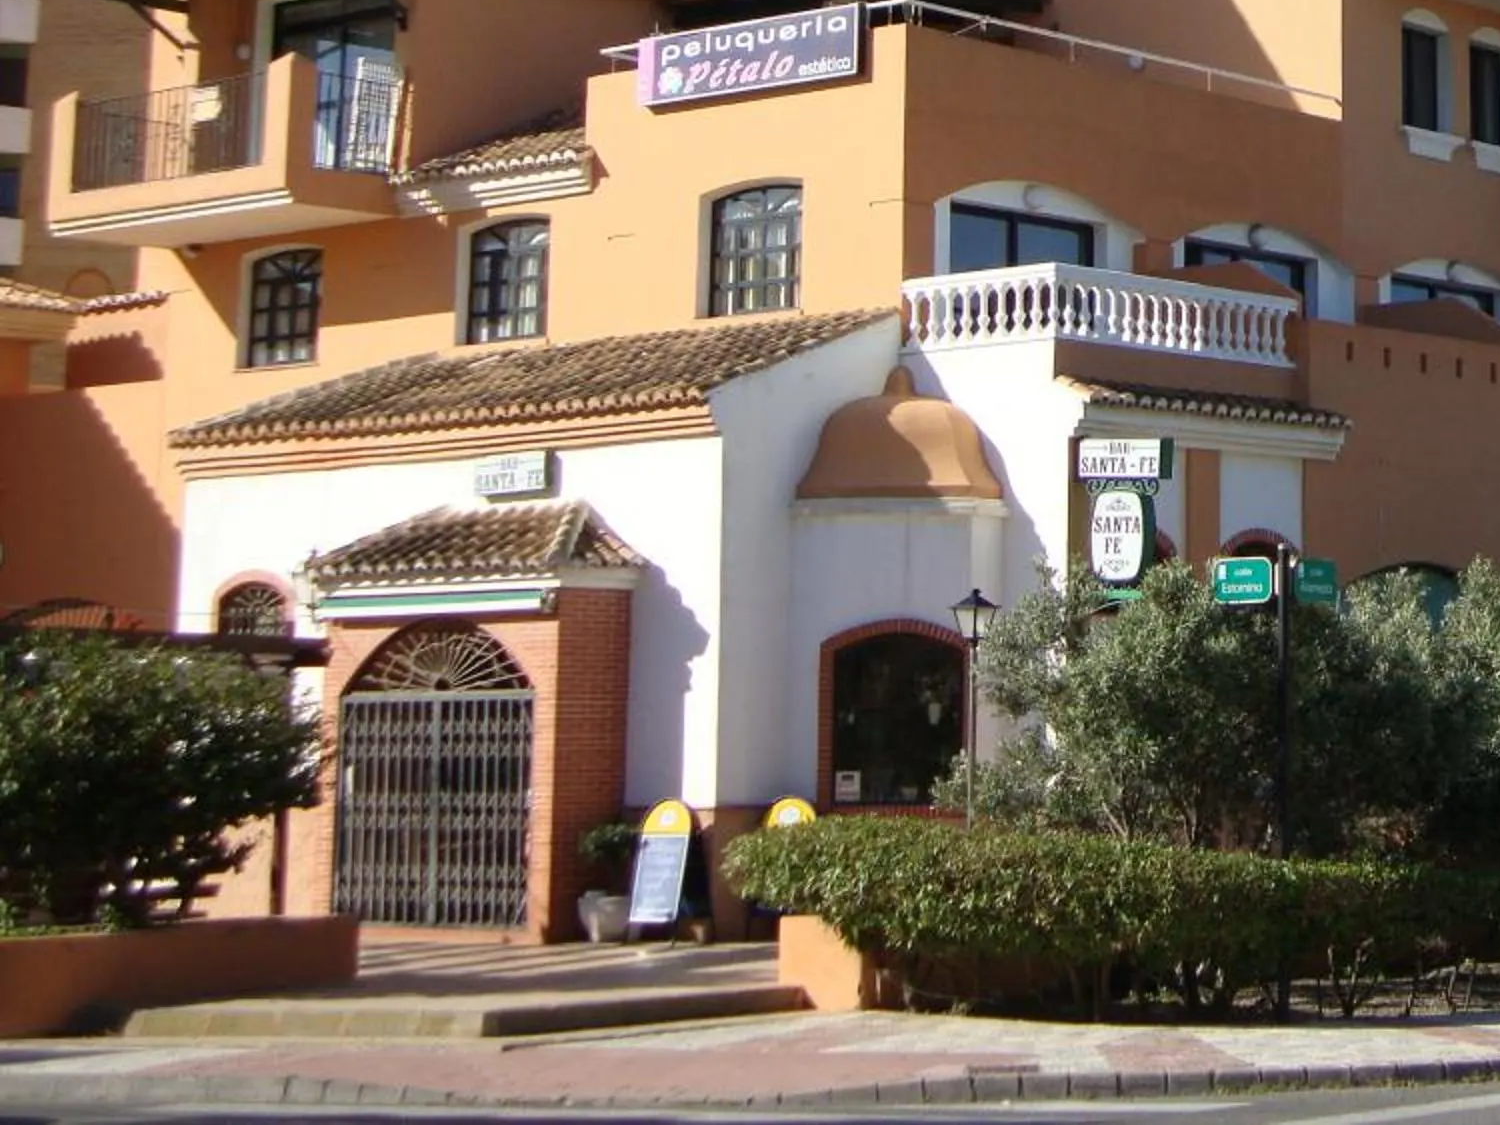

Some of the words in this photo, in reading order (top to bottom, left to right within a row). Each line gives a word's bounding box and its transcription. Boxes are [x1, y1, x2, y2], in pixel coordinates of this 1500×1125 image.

[683, 50, 795, 95] Pétalo
[1081, 457, 1127, 474] SANTA
[1140, 456, 1158, 473] FE
[1094, 516, 1141, 534] SANTA
[1104, 535, 1122, 555] FE
